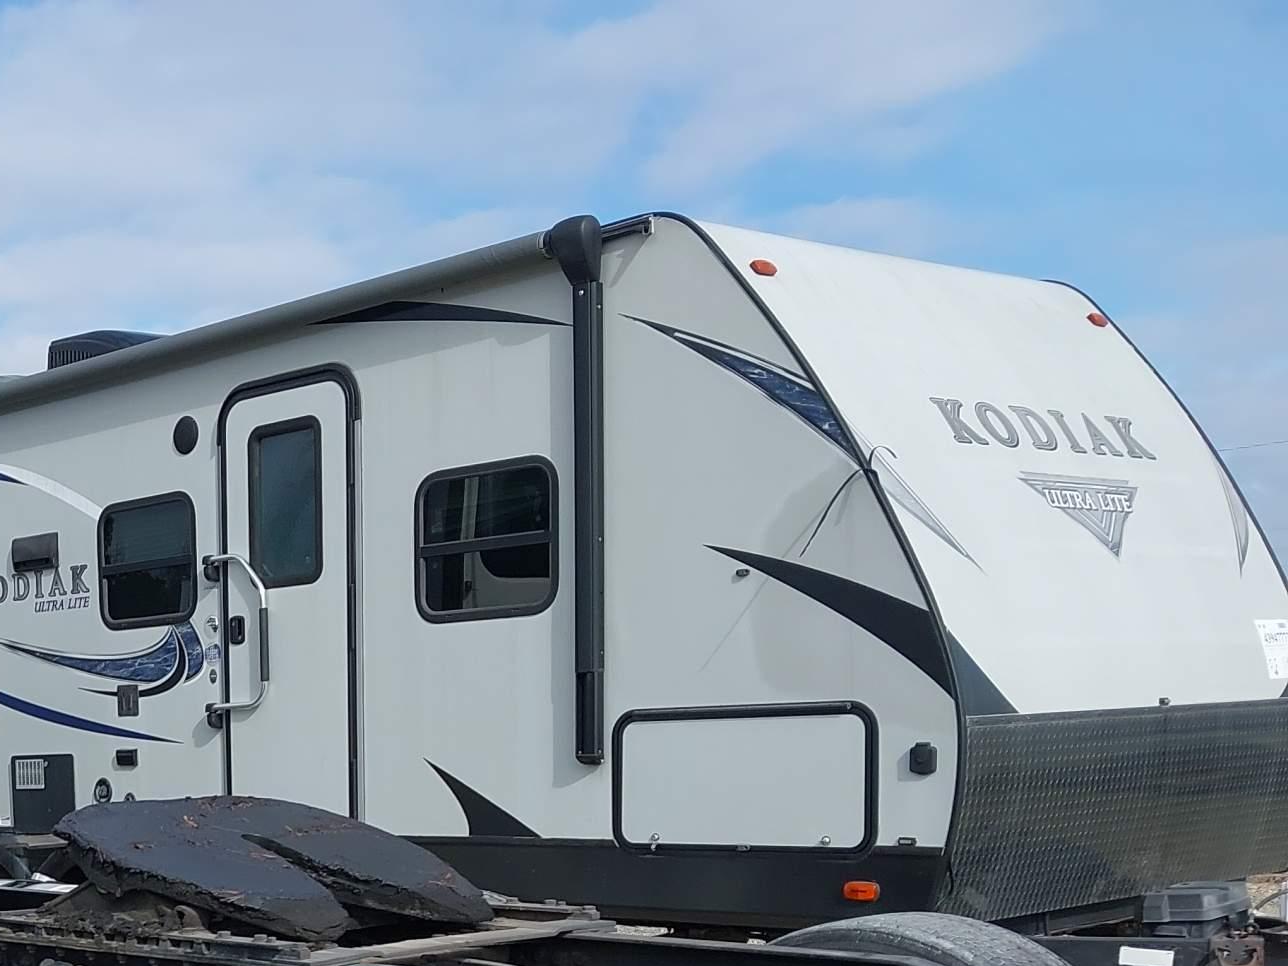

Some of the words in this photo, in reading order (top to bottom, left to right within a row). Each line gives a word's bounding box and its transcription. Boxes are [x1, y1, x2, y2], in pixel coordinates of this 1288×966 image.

[929, 397, 1157, 460] KODIAK
[1043, 488, 1098, 511] ULTRA
[1097, 492, 1133, 513] LITE
[34, 599, 64, 613] ULTRA
[67, 596, 90, 610] LITE
